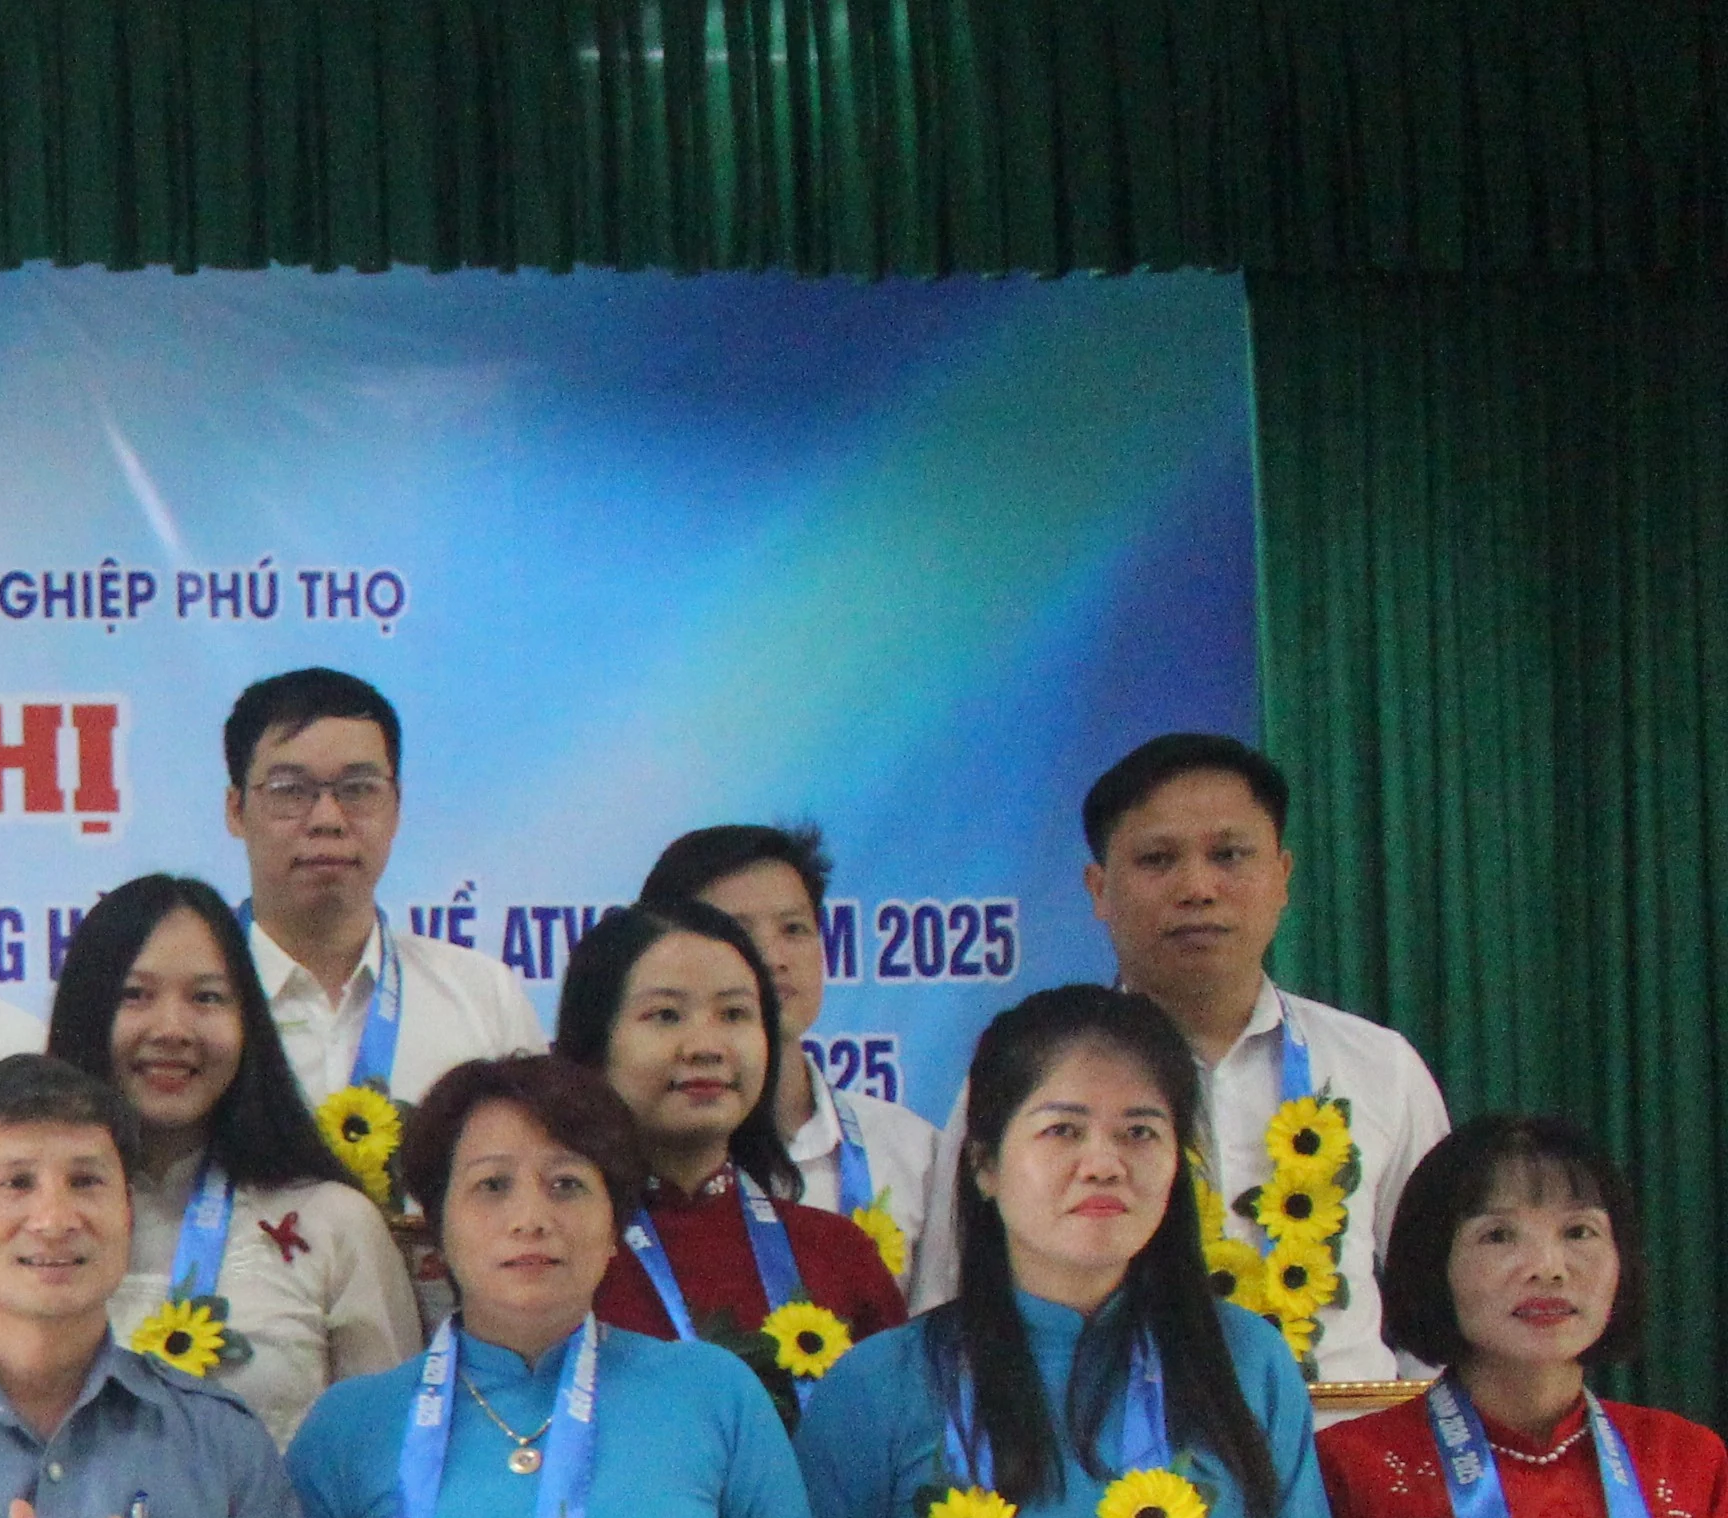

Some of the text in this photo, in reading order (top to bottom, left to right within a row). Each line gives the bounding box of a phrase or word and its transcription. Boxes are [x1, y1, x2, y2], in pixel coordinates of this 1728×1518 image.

[176, 557, 279, 619] PHÚ
[297, 570, 405, 632] THỌ
[877, 902, 1016, 978] 2025
[800, 1038, 898, 1103] 25
